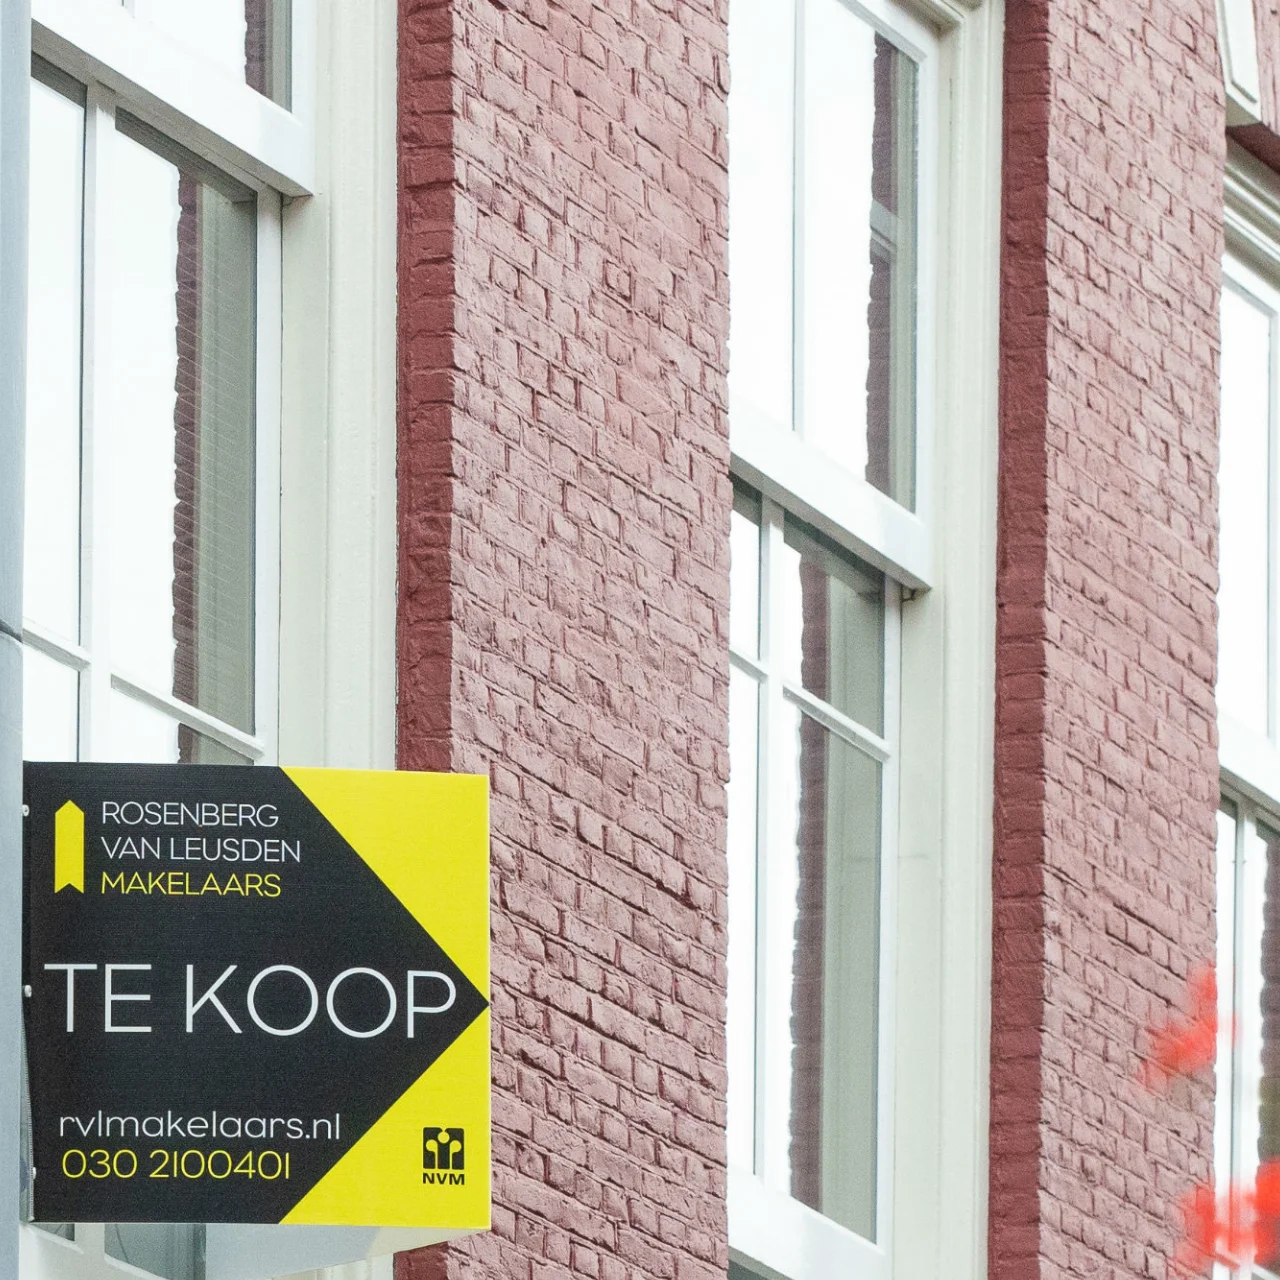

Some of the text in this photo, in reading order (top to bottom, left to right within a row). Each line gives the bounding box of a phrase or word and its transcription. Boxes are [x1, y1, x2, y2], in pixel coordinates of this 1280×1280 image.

[101, 801, 279, 828] ROSENBERG
[101, 836, 301, 863] VAN LEUSDEN
[101, 872, 281, 897] MAKELAARS
[44, 963, 457, 1039] TE KOOP
[59, 1110, 340, 1140] rvlmakelaars.nl
[62, 1149, 290, 1180] 030 2100401
[422, 1173, 465, 1186] NVM
